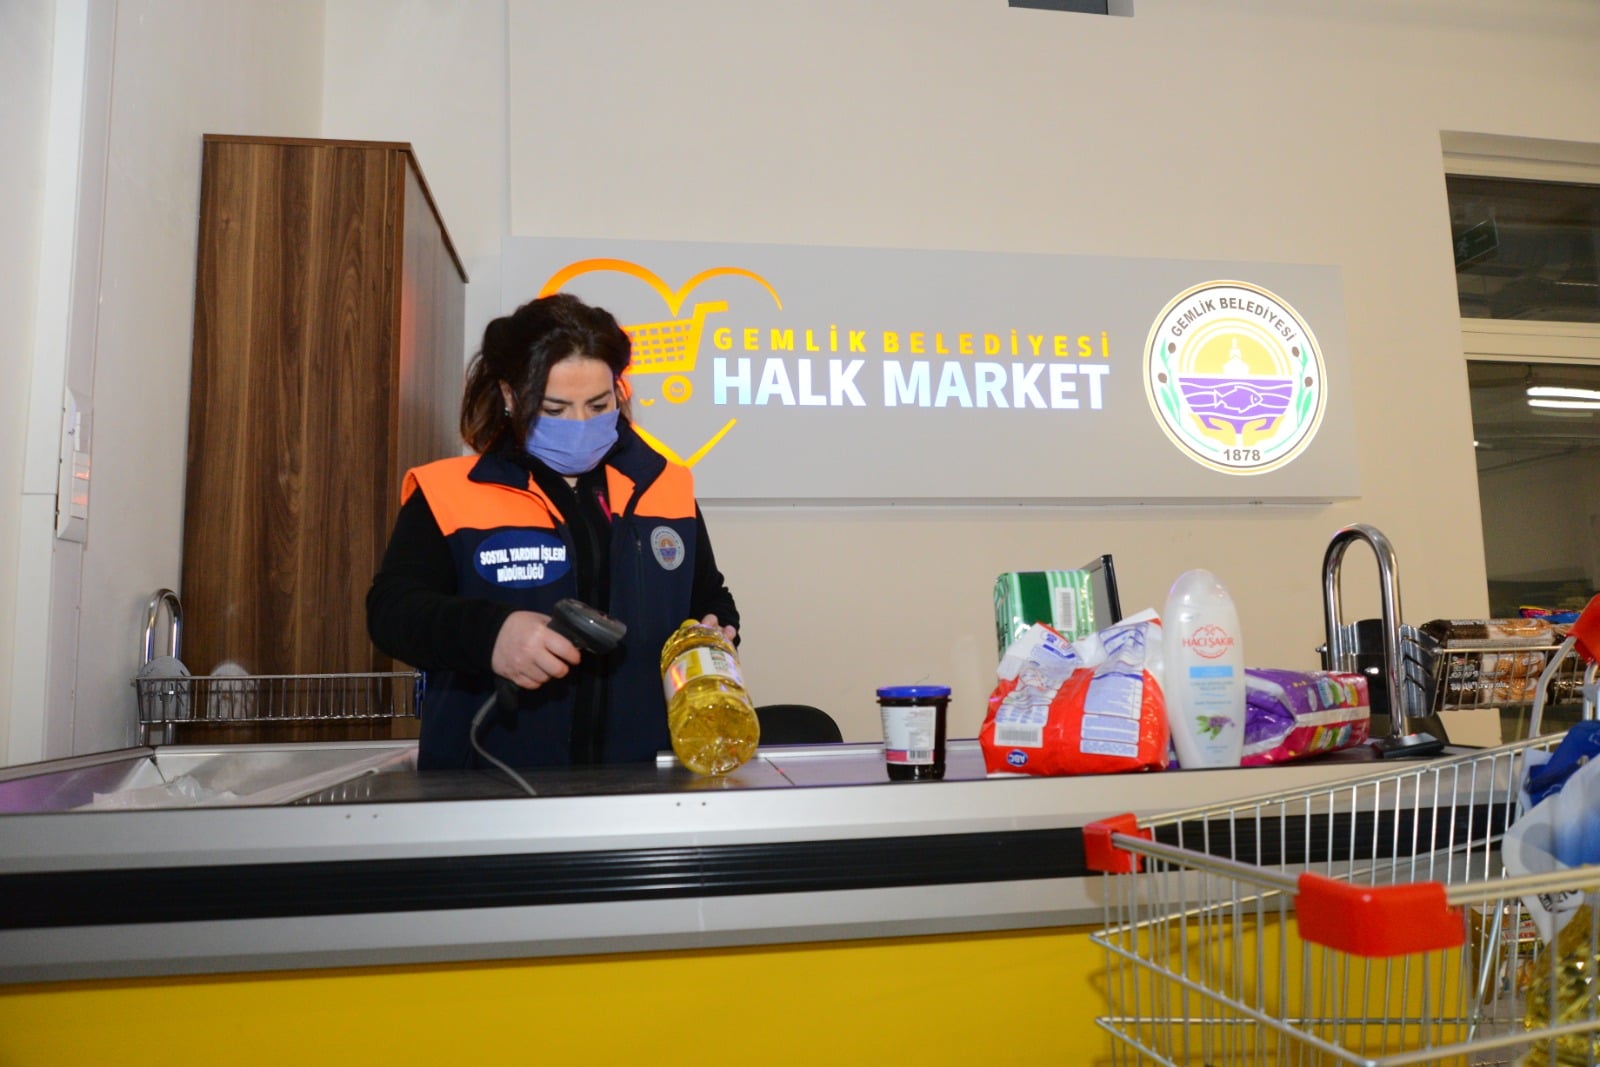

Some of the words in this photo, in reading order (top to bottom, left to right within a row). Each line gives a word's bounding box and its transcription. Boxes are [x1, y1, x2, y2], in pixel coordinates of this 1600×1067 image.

[1171, 299, 1216, 338] GEMLİK
[1219, 297, 1297, 342] BELEDİYESİ
[713, 324, 867, 353] GEMLİK
[882, 328, 1110, 358] BELEDİYESİ
[713, 357, 867, 406] HALK
[882, 359, 1110, 410] MARKET
[1223, 448, 1261, 462] 1878
[480, 549, 509, 566] SOSYAL
[540, 544, 566, 564] İŞLERİ
